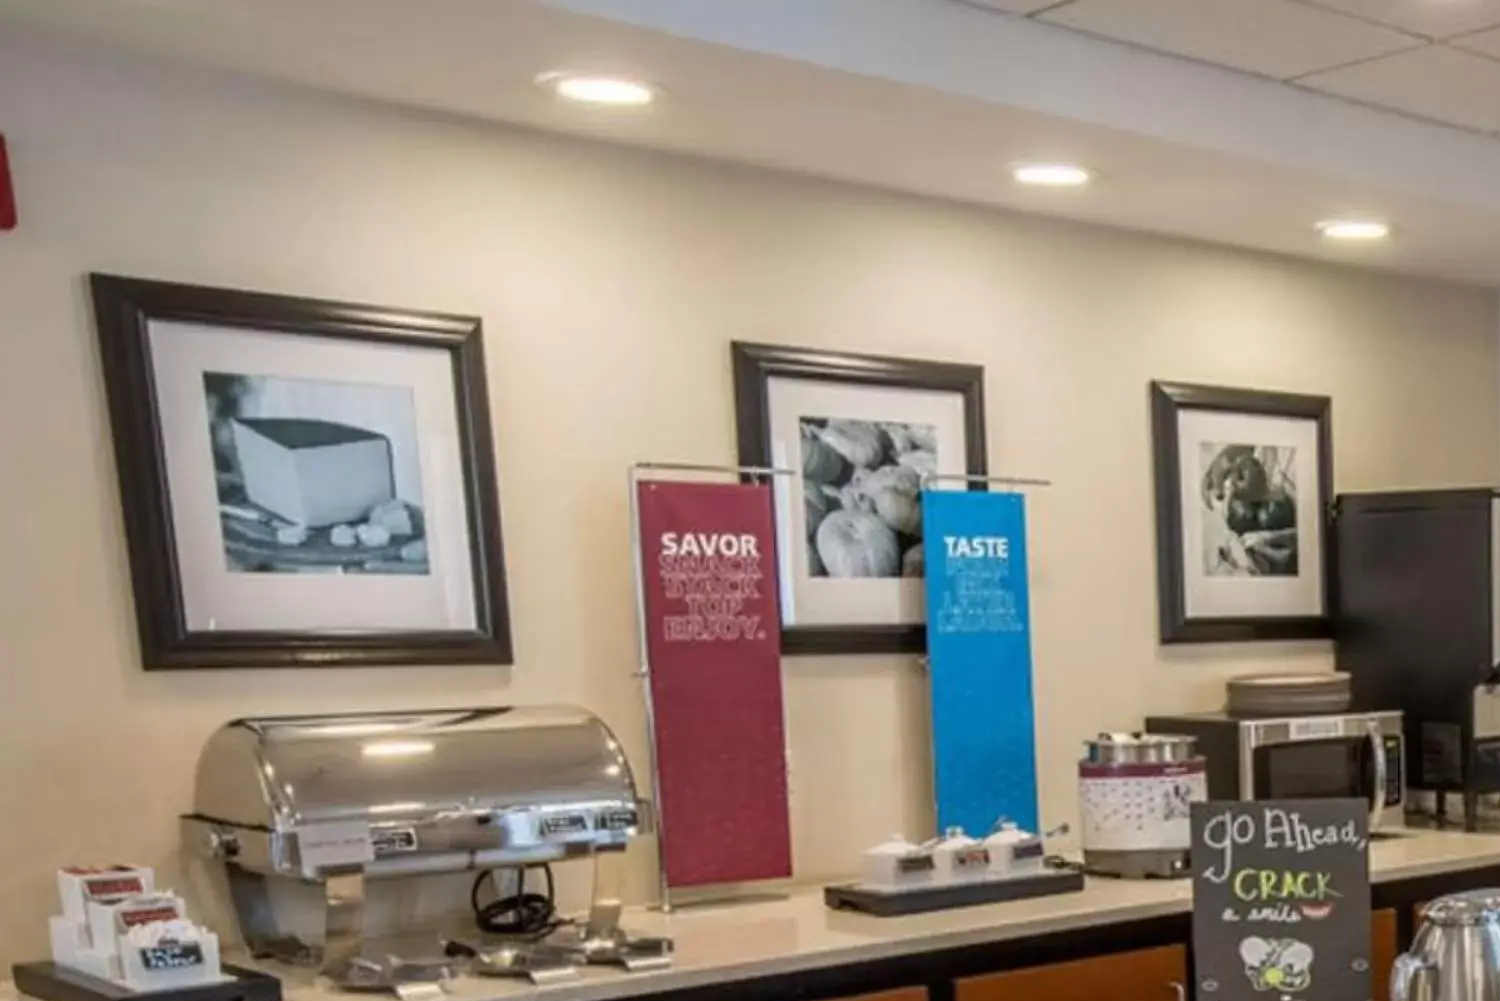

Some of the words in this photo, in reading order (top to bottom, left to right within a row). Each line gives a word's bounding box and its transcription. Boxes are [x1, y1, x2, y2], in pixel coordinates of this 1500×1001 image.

[661, 532, 758, 557] SAVOR
[943, 536, 1008, 559] TASTE
[1264, 808, 1368, 852] Ahead,
[1234, 868, 1344, 901] CRACK
[1221, 907, 1240, 921] a
[1247, 902, 1302, 922] smile
